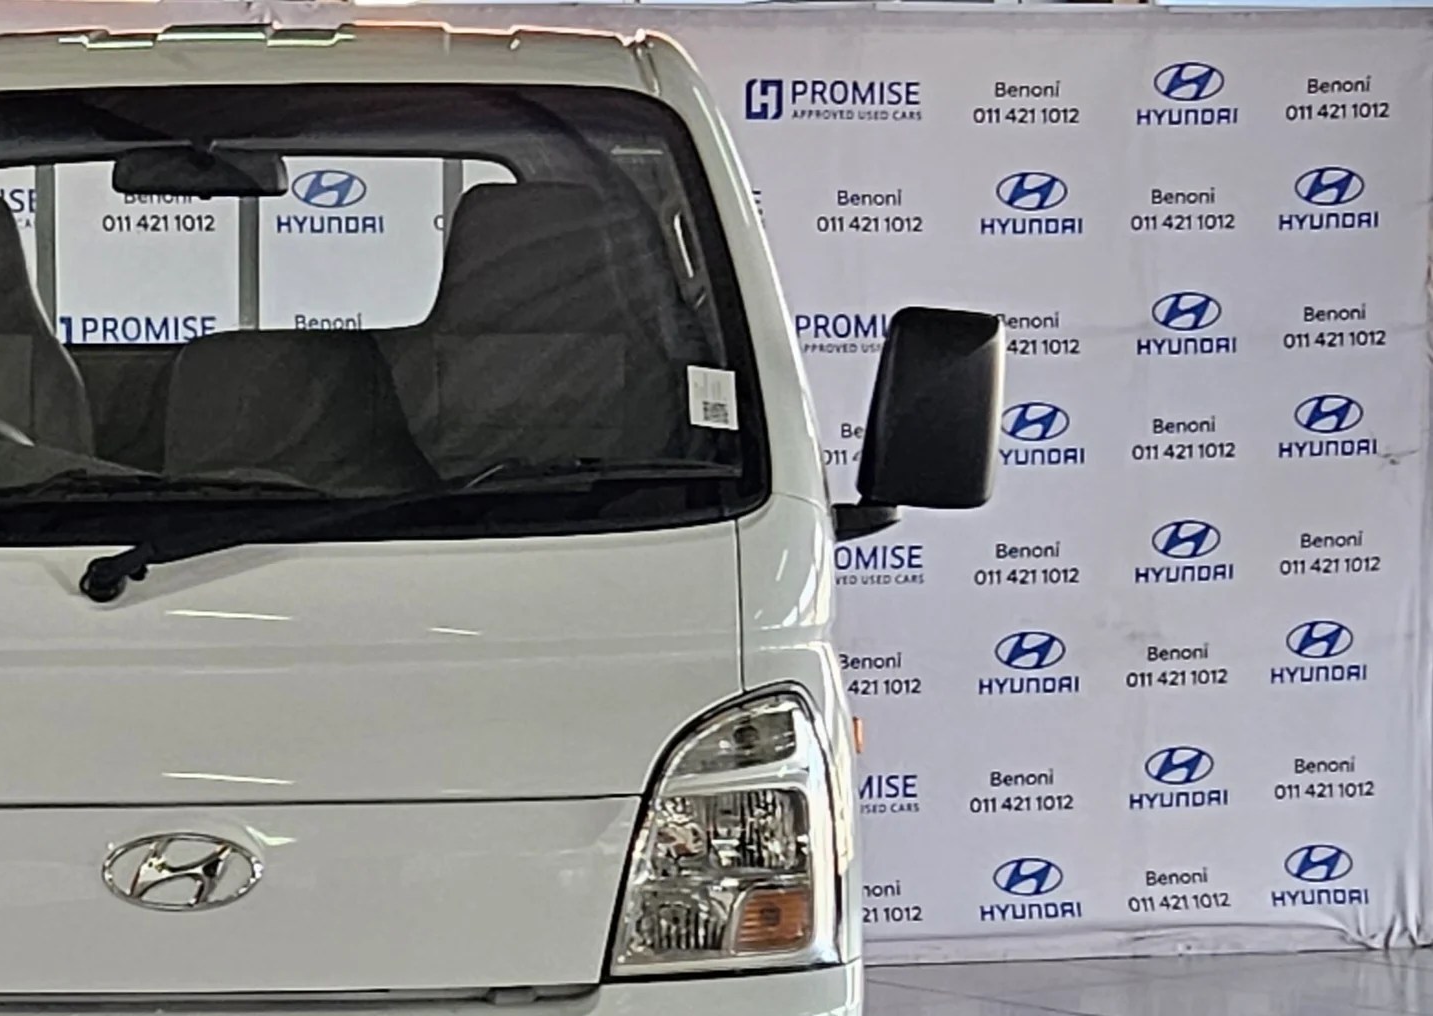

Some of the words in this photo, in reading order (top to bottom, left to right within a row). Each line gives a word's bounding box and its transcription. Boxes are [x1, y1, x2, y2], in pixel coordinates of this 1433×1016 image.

[791, 79, 921, 106] PROMISE
[994, 79, 1061, 98] Benoni
[1307, 74, 1372, 95] Benoni
[791, 109, 855, 120] APPROVED
[857, 109, 889, 121] USED
[892, 110, 922, 121] CARS
[973, 107, 1001, 124] 011
[1004, 107, 1036, 124] 421
[1041, 107, 1080, 124] 1012
[1136, 107, 1239, 126] HYUNDAI
[1285, 104, 1313, 122] 011
[1316, 103, 1347, 120] 421
[1351, 102, 1390, 119] 1012
[837, 188, 902, 207] Benoni
[1151, 186, 1216, 205] Benoni
[102, 214, 131, 233] 011
[135, 214, 169, 232] 421
[174, 214, 216, 232] 1012
[276, 214, 385, 234] HYUNDAI
[816, 215, 844, 233] 011
[848, 215, 879, 233] 421
[883, 216, 923, 233] 1012
[980, 217, 1083, 235] HYUNDAI
[1130, 215, 1157, 231] 011
[1161, 214, 1192, 231] 421
[1196, 213, 1236, 230] 1012
[1278, 210, 1379, 231] HYUNDAI
[1303, 303, 1367, 322] Benoni
[82, 316, 216, 342] PROMISE
[795, 314, 889, 339] PROMI
[803, 343, 858, 353] PPROVED
[1006, 339, 1038, 356] 421
[1041, 338, 1081, 355] 1012
[1136, 336, 1237, 356] HYUNDAI
[1283, 332, 1310, 350] 011
[1314, 331, 1344, 348] 421
[1348, 329, 1387, 346] 1012
[1152, 415, 1216, 435] Benoni
[998, 448, 1084, 466] YUNDAI
[1131, 444, 1159, 461] 011
[1162, 443, 1194, 460] 421
[1197, 442, 1236, 459] 1012
[1278, 438, 1378, 459] HYUNDAI
[1300, 530, 1364, 549] Benoni
[834, 545, 923, 570] OMISE
[995, 540, 1061, 559] Benoni
[1134, 563, 1234, 584] HYUNDAI
[1279, 559, 1306, 576] 011
[1309, 557, 1340, 574] 421
[1344, 555, 1381, 573] 1012
[860, 574, 892, 586] USED
[894, 573, 925, 585] CARS
[973, 569, 1002, 586] 011
[1006, 568, 1037, 585] 421
[1041, 567, 1080, 584] 1012
[1146, 642, 1209, 662] Benoni
[1125, 671, 1153, 688] 011
[1156, 670, 1186, 687] 421
[1190, 668, 1228, 685] 1012
[1270, 664, 1367, 684] HYUNDAI
[847, 679, 878, 696] 421
[883, 677, 922, 695] 1012
[978, 675, 1080, 696] HYUNDAI
[1294, 756, 1355, 775] Benoni
[989, 768, 1054, 787] Benoni
[1129, 789, 1229, 810] HYUNDAI
[1274, 783, 1300, 800] 011
[1304, 782, 1334, 799] 421
[1337, 780, 1375, 798] 1012
[889, 802, 920, 814] CARS
[969, 796, 997, 814] 011
[1000, 795, 1031, 812] 421
[1035, 794, 1074, 812] 1012
[1145, 866, 1208, 887] Benoni
[863, 881, 900, 897] noni
[1271, 888, 1370, 907] HYUNDAI
[979, 901, 1082, 922] HYUNDAI
[1127, 896, 1156, 913] 011
[1158, 894, 1189, 911] 421
[1191, 892, 1231, 909] 1012
[863, 908, 878, 923] 21
[883, 905, 923, 923] 1012
